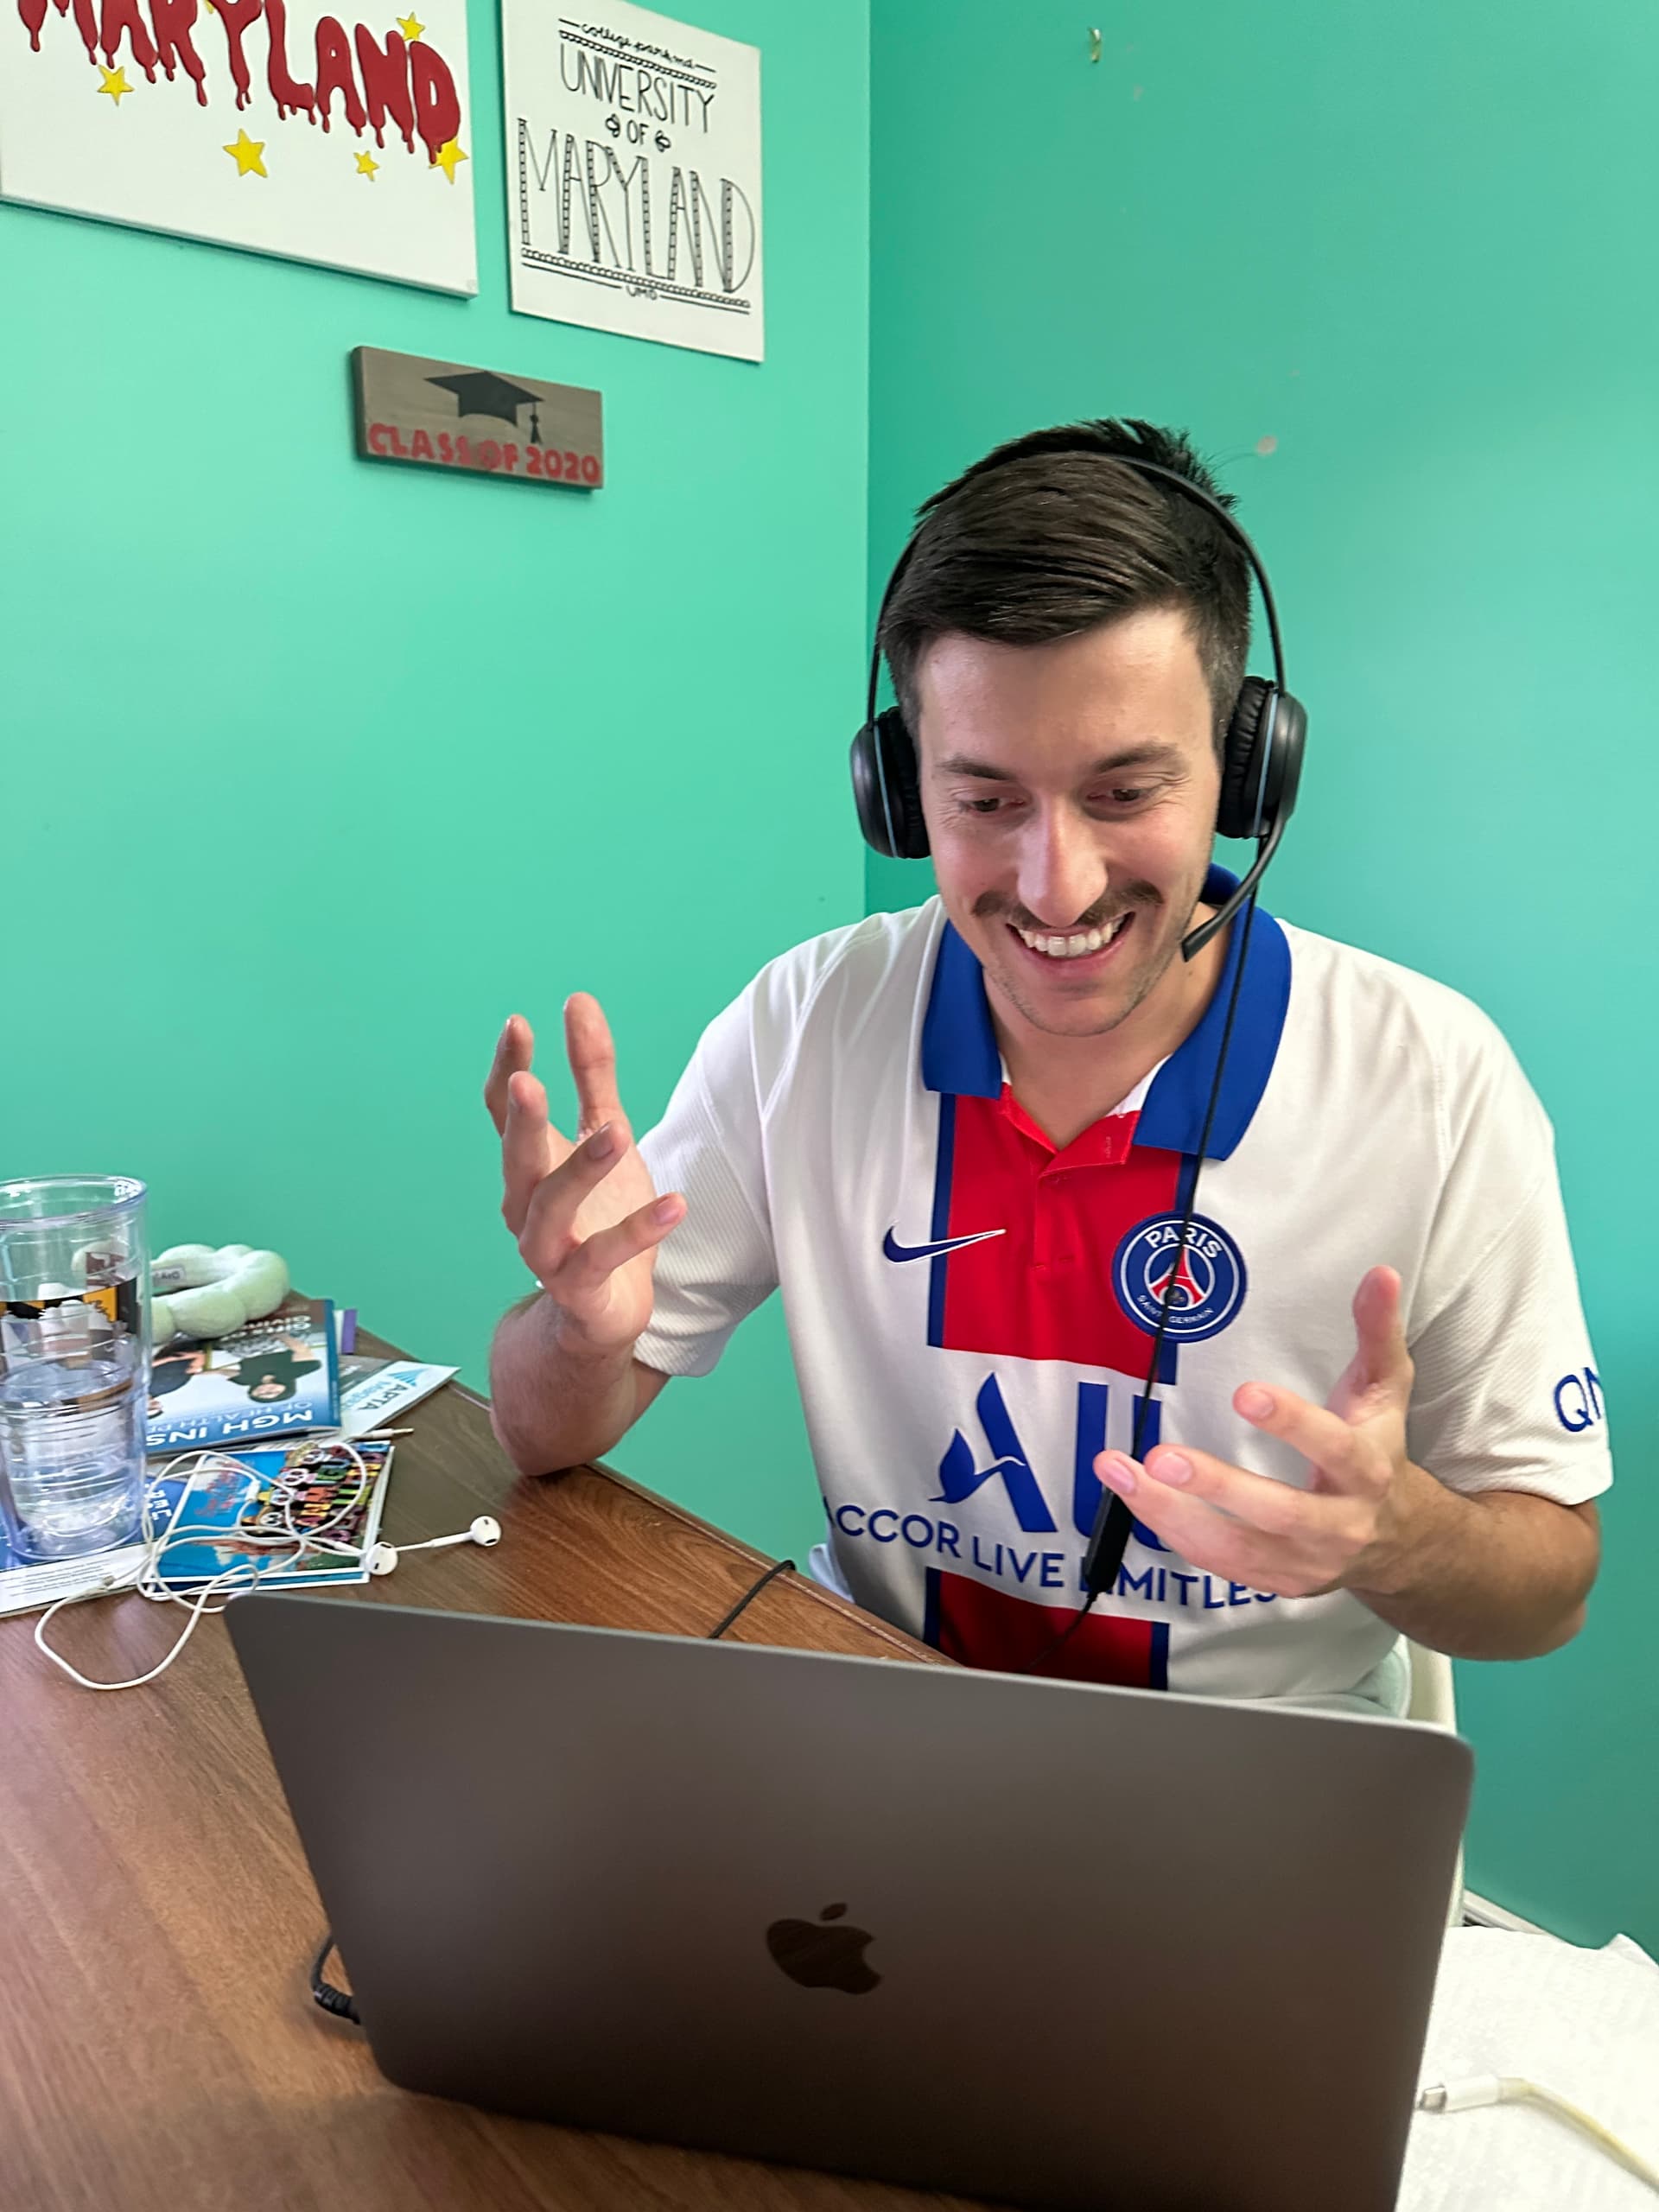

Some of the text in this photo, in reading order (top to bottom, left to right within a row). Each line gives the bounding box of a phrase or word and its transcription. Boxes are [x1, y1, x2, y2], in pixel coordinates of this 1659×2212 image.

[561, 43, 715, 133] UNIVERSITY
[626, 119, 650, 145] OF
[518, 118, 755, 293] MARYLAND
[368, 423, 601, 484] CLASS OF 2020
[1144, 1226, 1223, 1258] PARIS
[357, 1383, 409, 1410] APTA
[222, 1409, 313, 1434] MGH
[823, 1496, 962, 1558] CCOR
[973, 1535, 1065, 1588] LIVE
